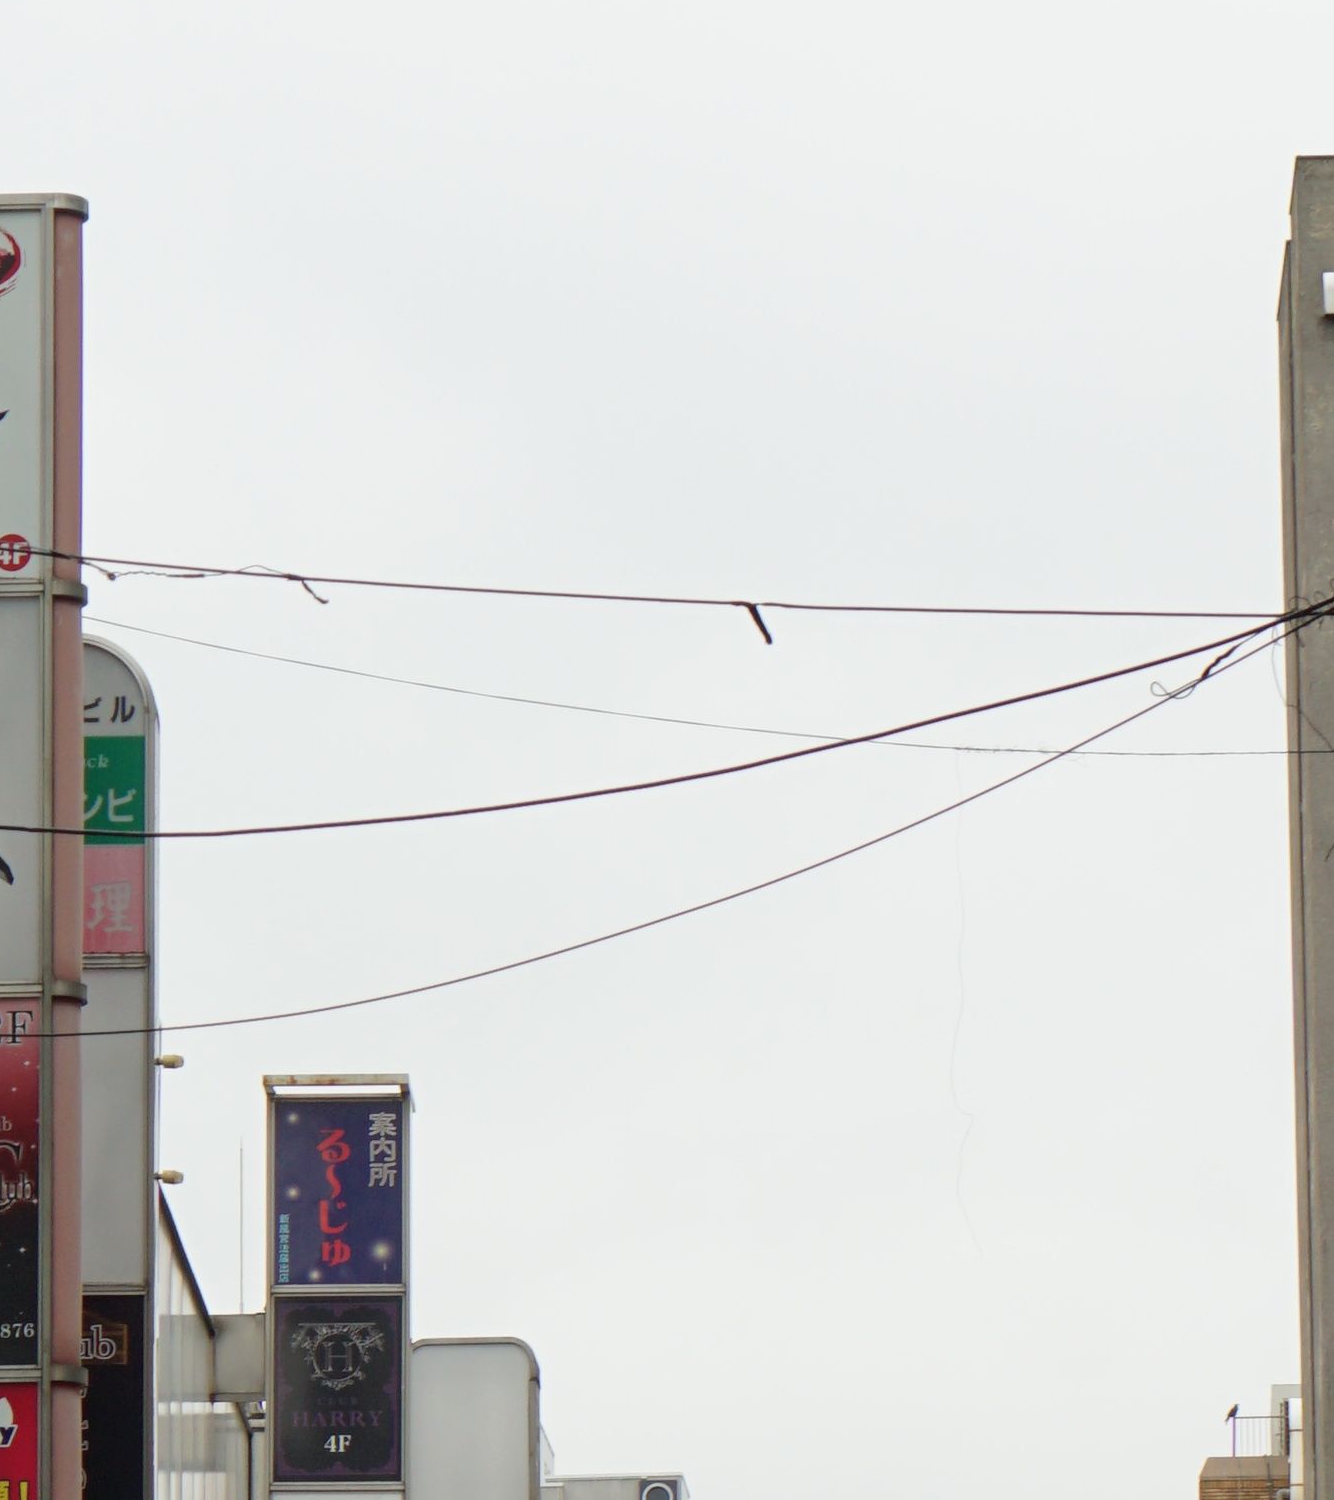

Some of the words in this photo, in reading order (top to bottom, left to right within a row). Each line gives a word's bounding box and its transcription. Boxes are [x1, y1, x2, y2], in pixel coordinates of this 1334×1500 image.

[88, 881, 134, 934] 理
[368, 1111, 398, 1188] 案内所
[292, 1408, 384, 1429] HARRY
[323, 1434, 352, 1454] 4F
